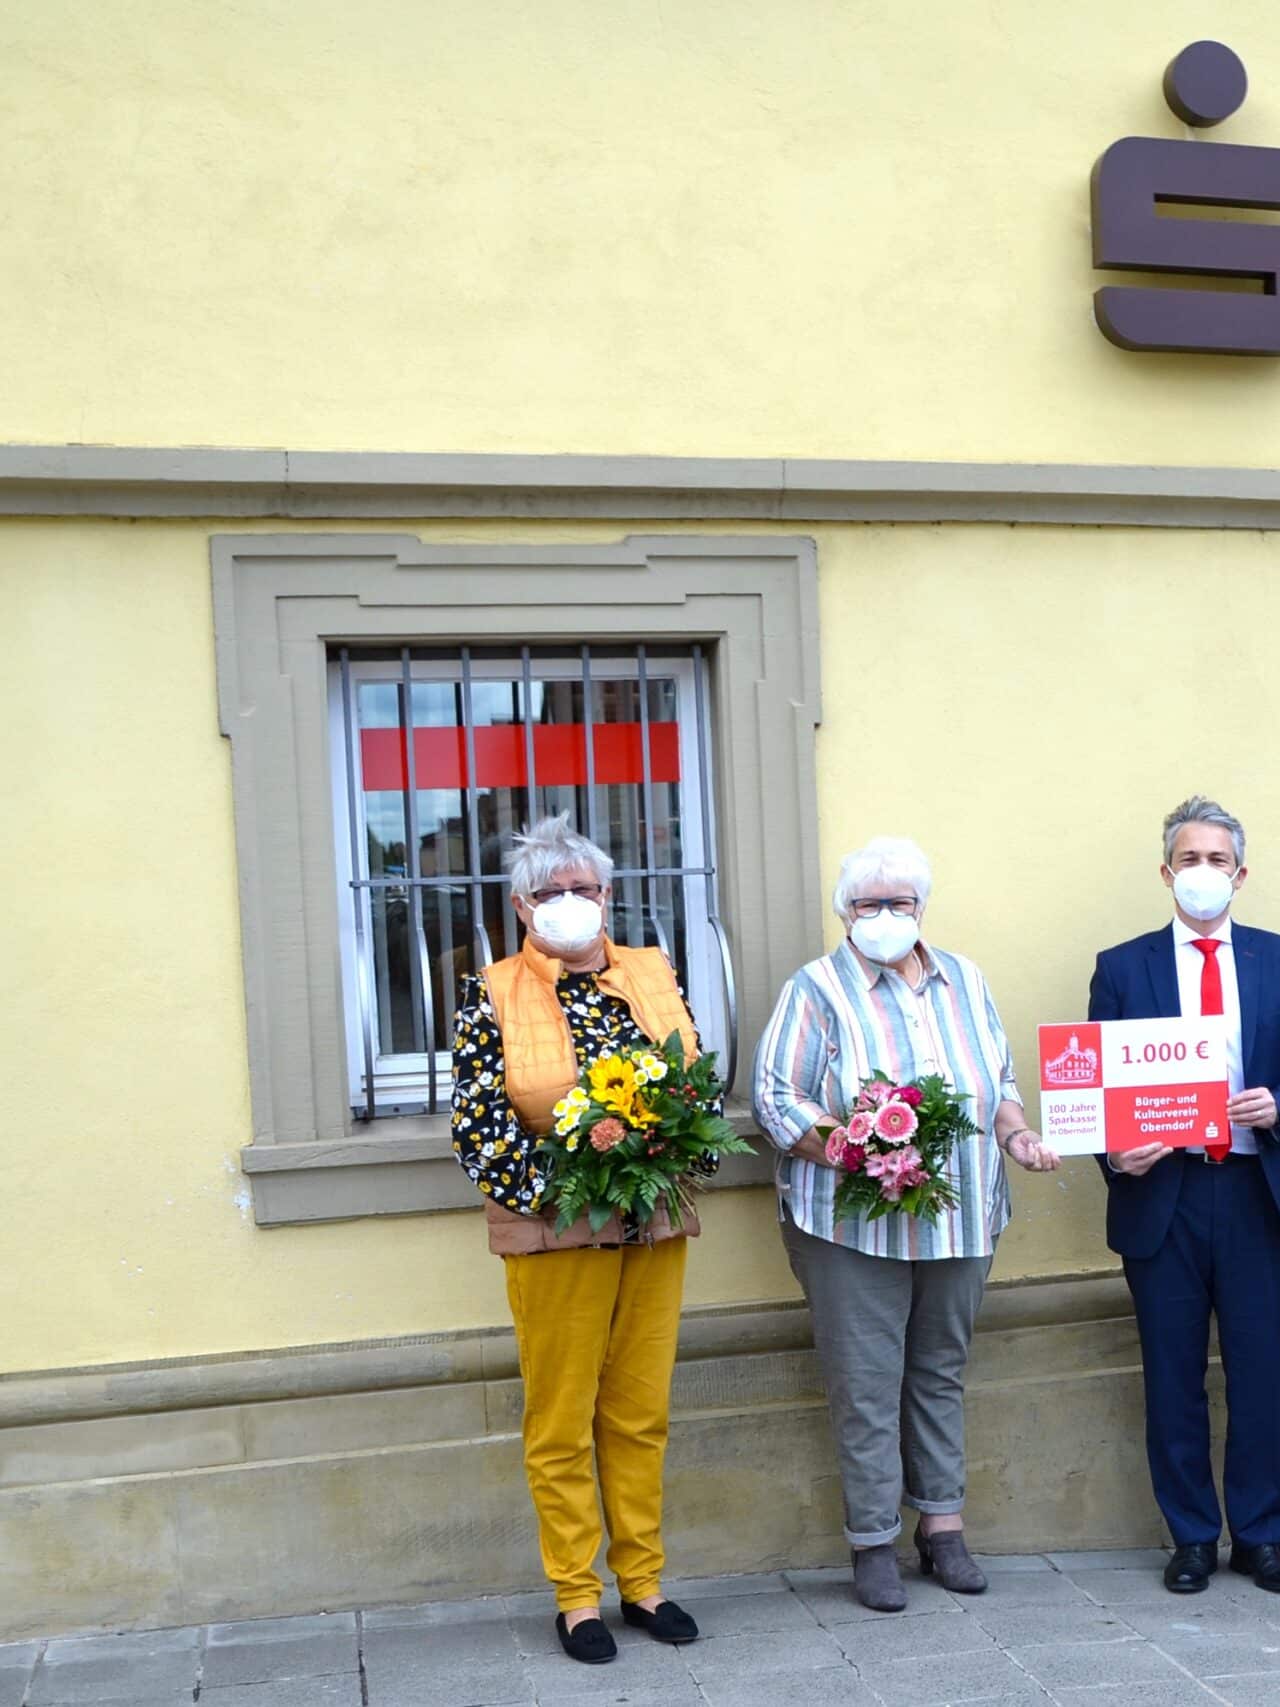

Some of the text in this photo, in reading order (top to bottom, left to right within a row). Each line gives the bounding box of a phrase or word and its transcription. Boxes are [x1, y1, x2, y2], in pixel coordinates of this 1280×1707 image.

[1121, 1040, 1209, 1065] 1.000 €
[1135, 1094, 1197, 1108] Bürger- und
[1048, 1103, 1097, 1114] 100 Jahre
[1134, 1107, 1199, 1120] Kulturverein
[1048, 1114, 1097, 1126] Sparkasse
[1140, 1120, 1194, 1133] Oberndorf
[1058, 1126, 1097, 1136] Oberndorf
